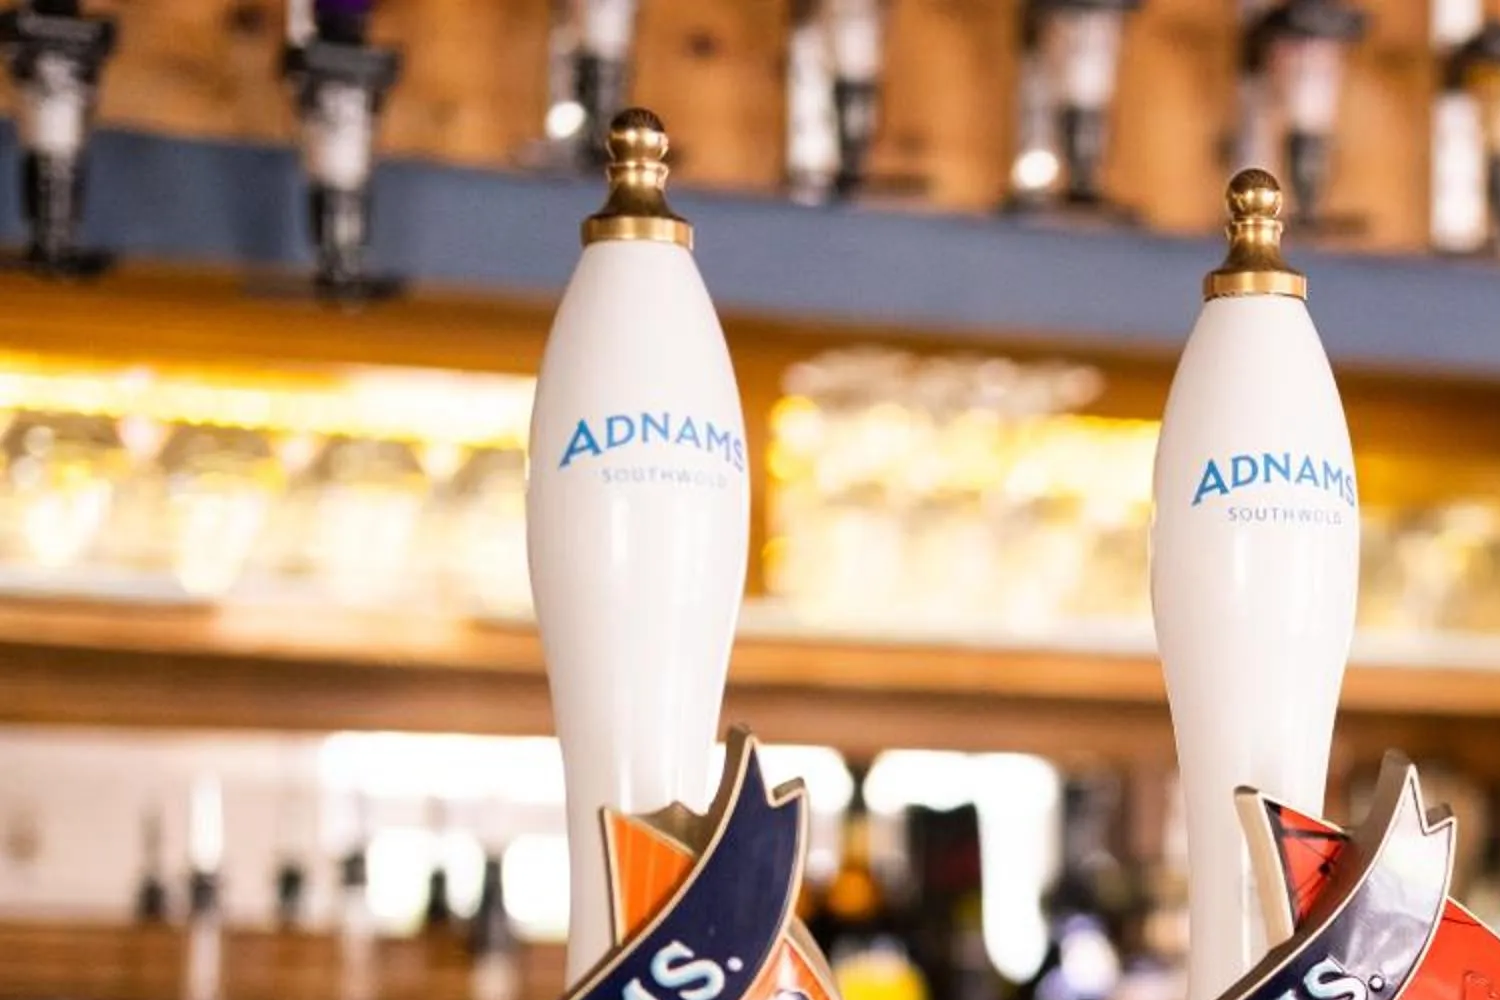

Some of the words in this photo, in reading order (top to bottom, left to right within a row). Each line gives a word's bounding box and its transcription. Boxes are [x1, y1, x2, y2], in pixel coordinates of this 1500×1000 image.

[558, 412, 744, 473] ADNAMS
[1191, 453, 1355, 507] ADNAMS
[1227, 506, 1342, 526] SOUTHWOLD
